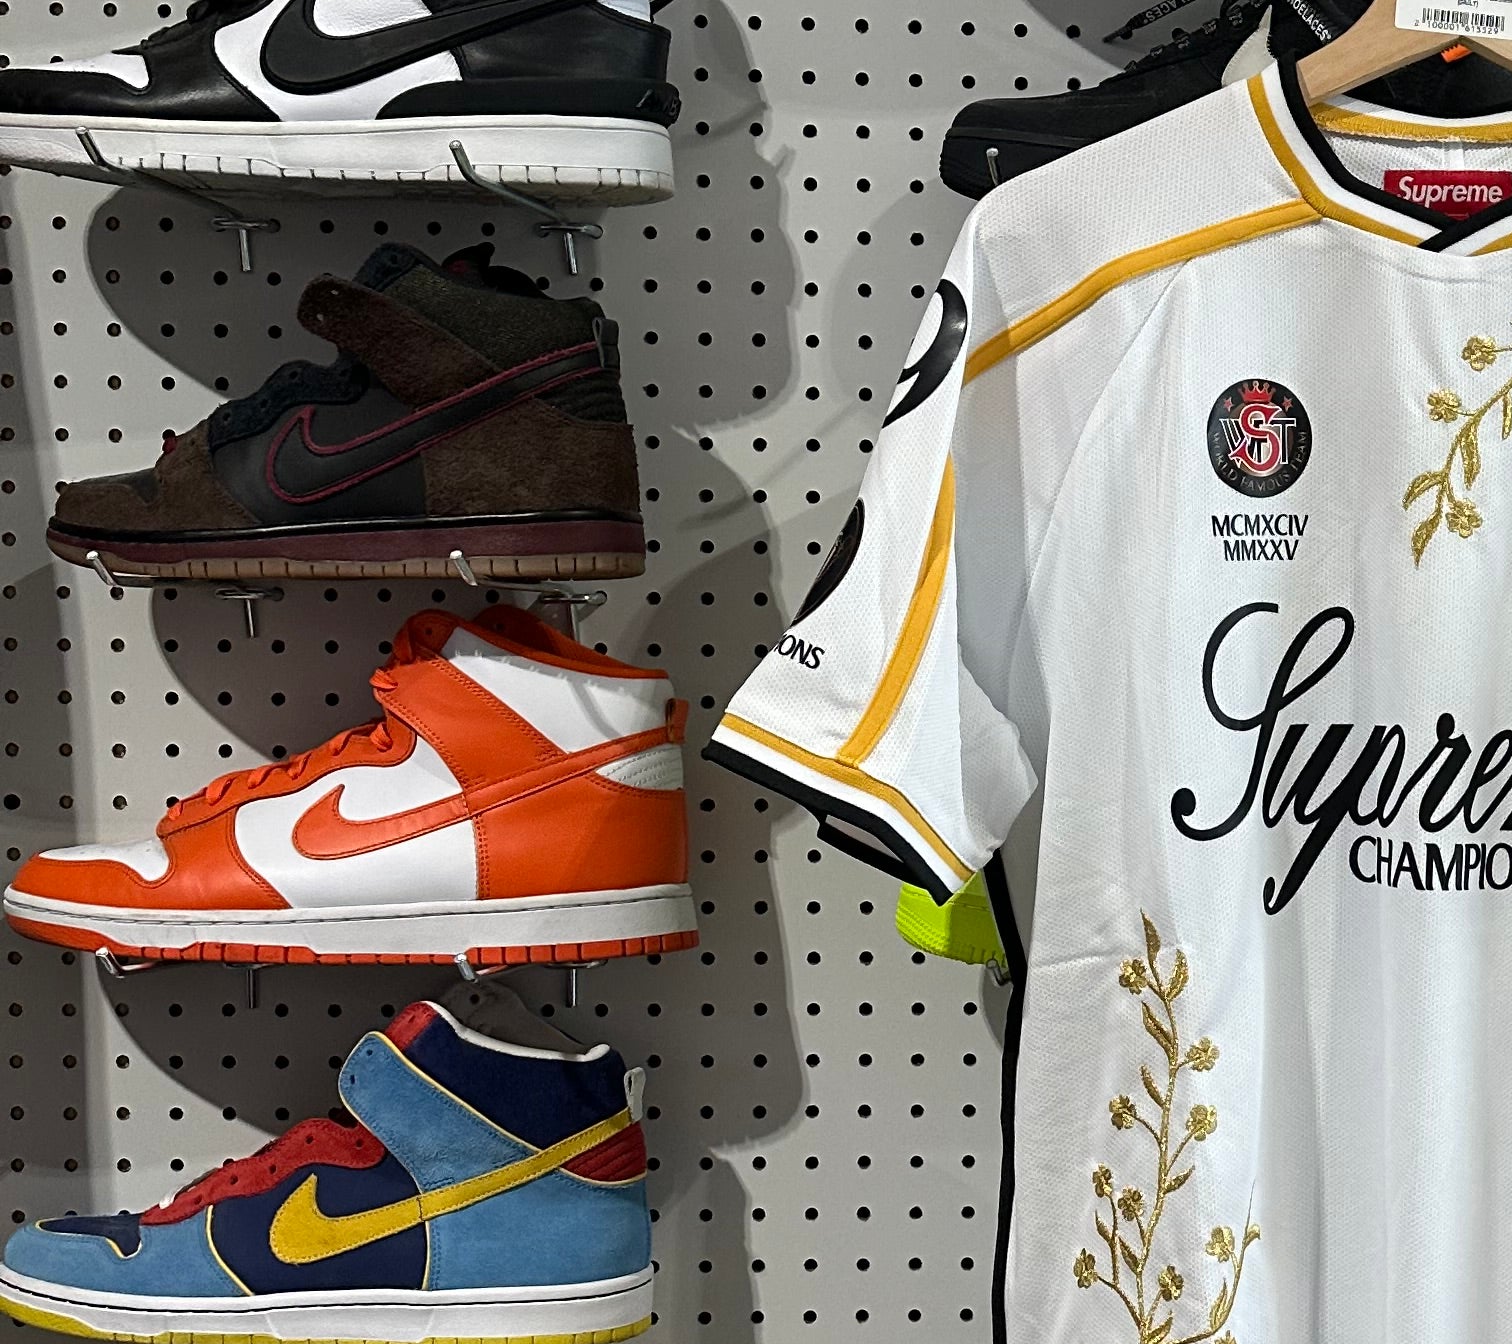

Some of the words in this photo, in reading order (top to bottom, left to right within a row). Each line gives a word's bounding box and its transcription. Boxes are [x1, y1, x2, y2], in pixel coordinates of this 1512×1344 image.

[1397, 175, 1504, 209] Supreme
[1211, 513, 1309, 537] MCMXCIV
[1223, 539, 1300, 561] MMXXV
